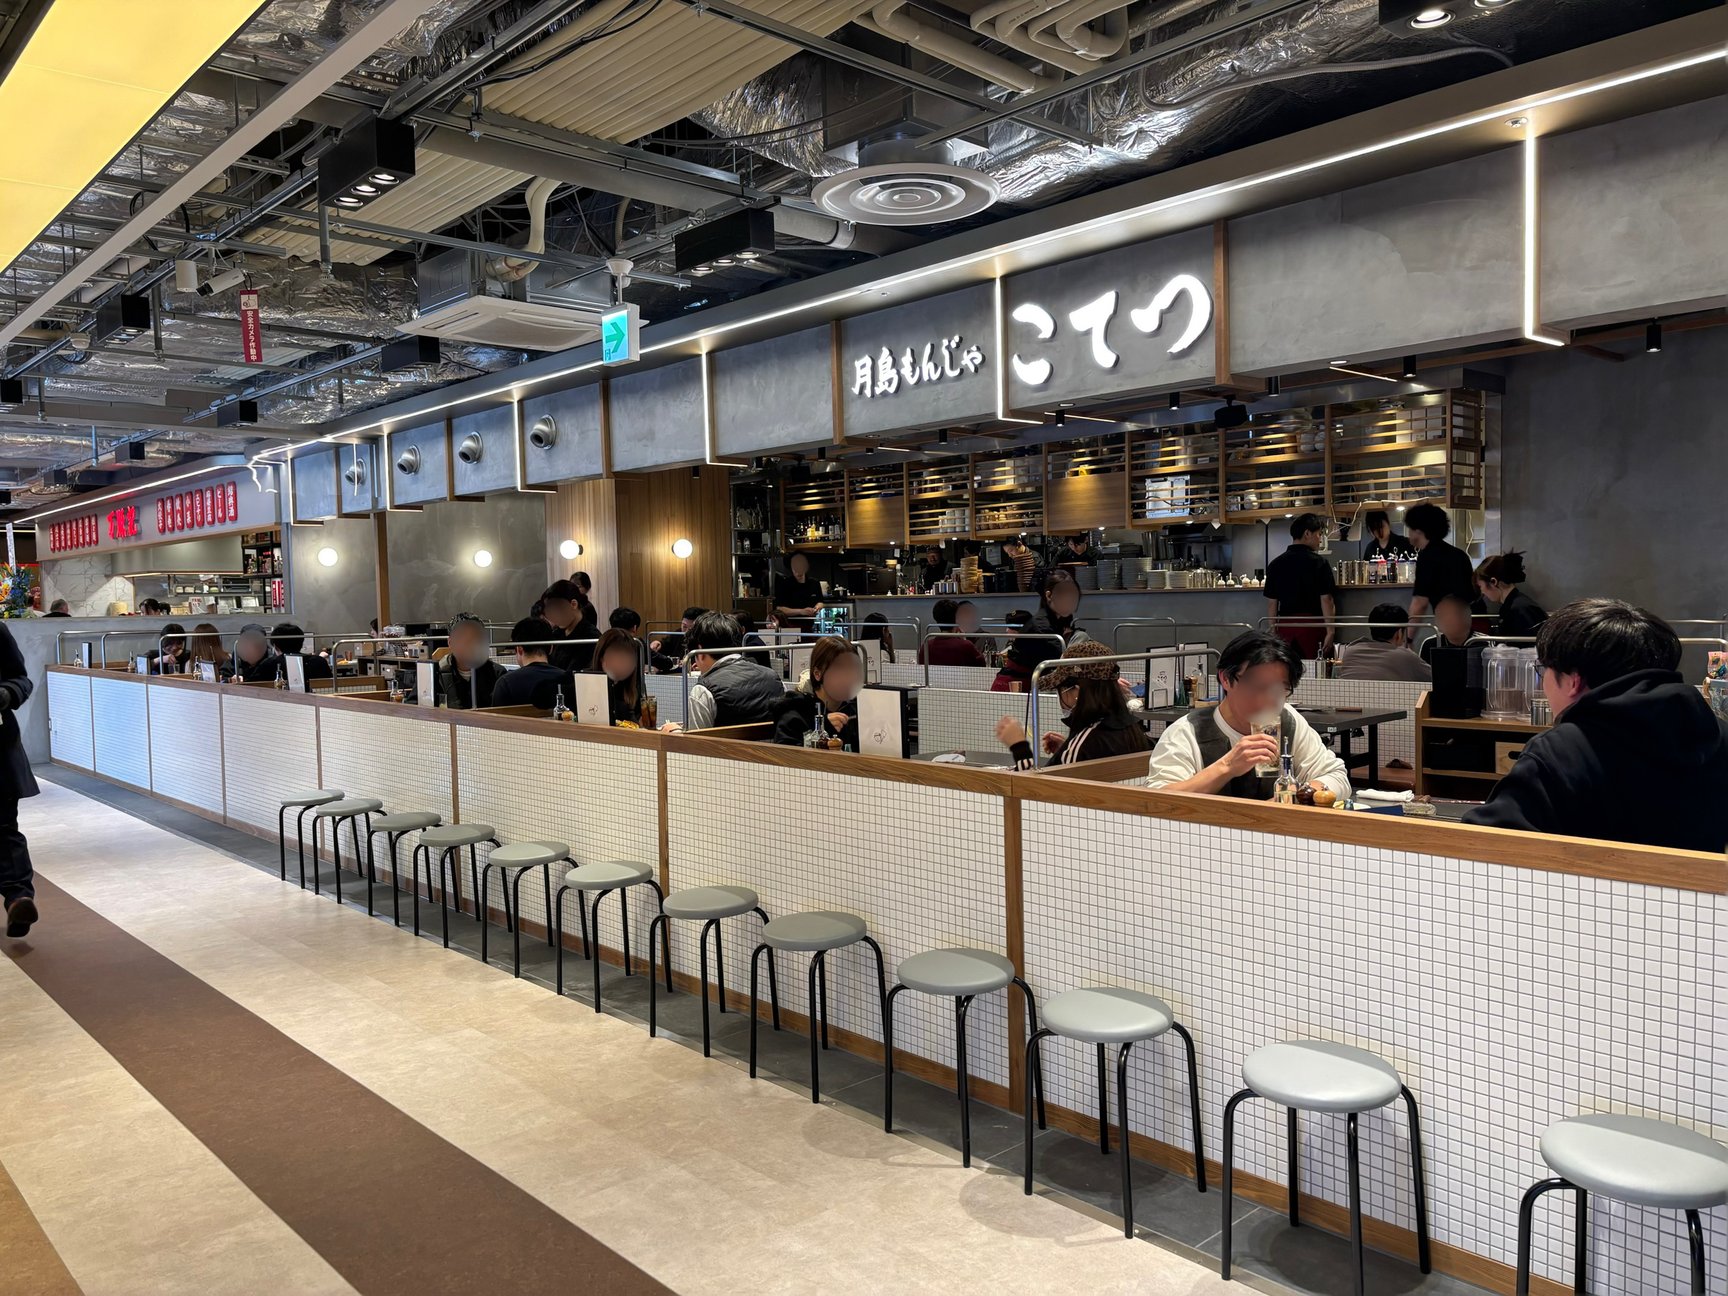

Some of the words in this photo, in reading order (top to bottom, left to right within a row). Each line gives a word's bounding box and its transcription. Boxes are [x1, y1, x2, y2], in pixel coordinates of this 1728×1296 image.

[246, 310, 257, 362] 安全カメラ作動中
[851, 335, 984, 398] 月島もんじゃ
[1011, 273, 1213, 386] こてつ
